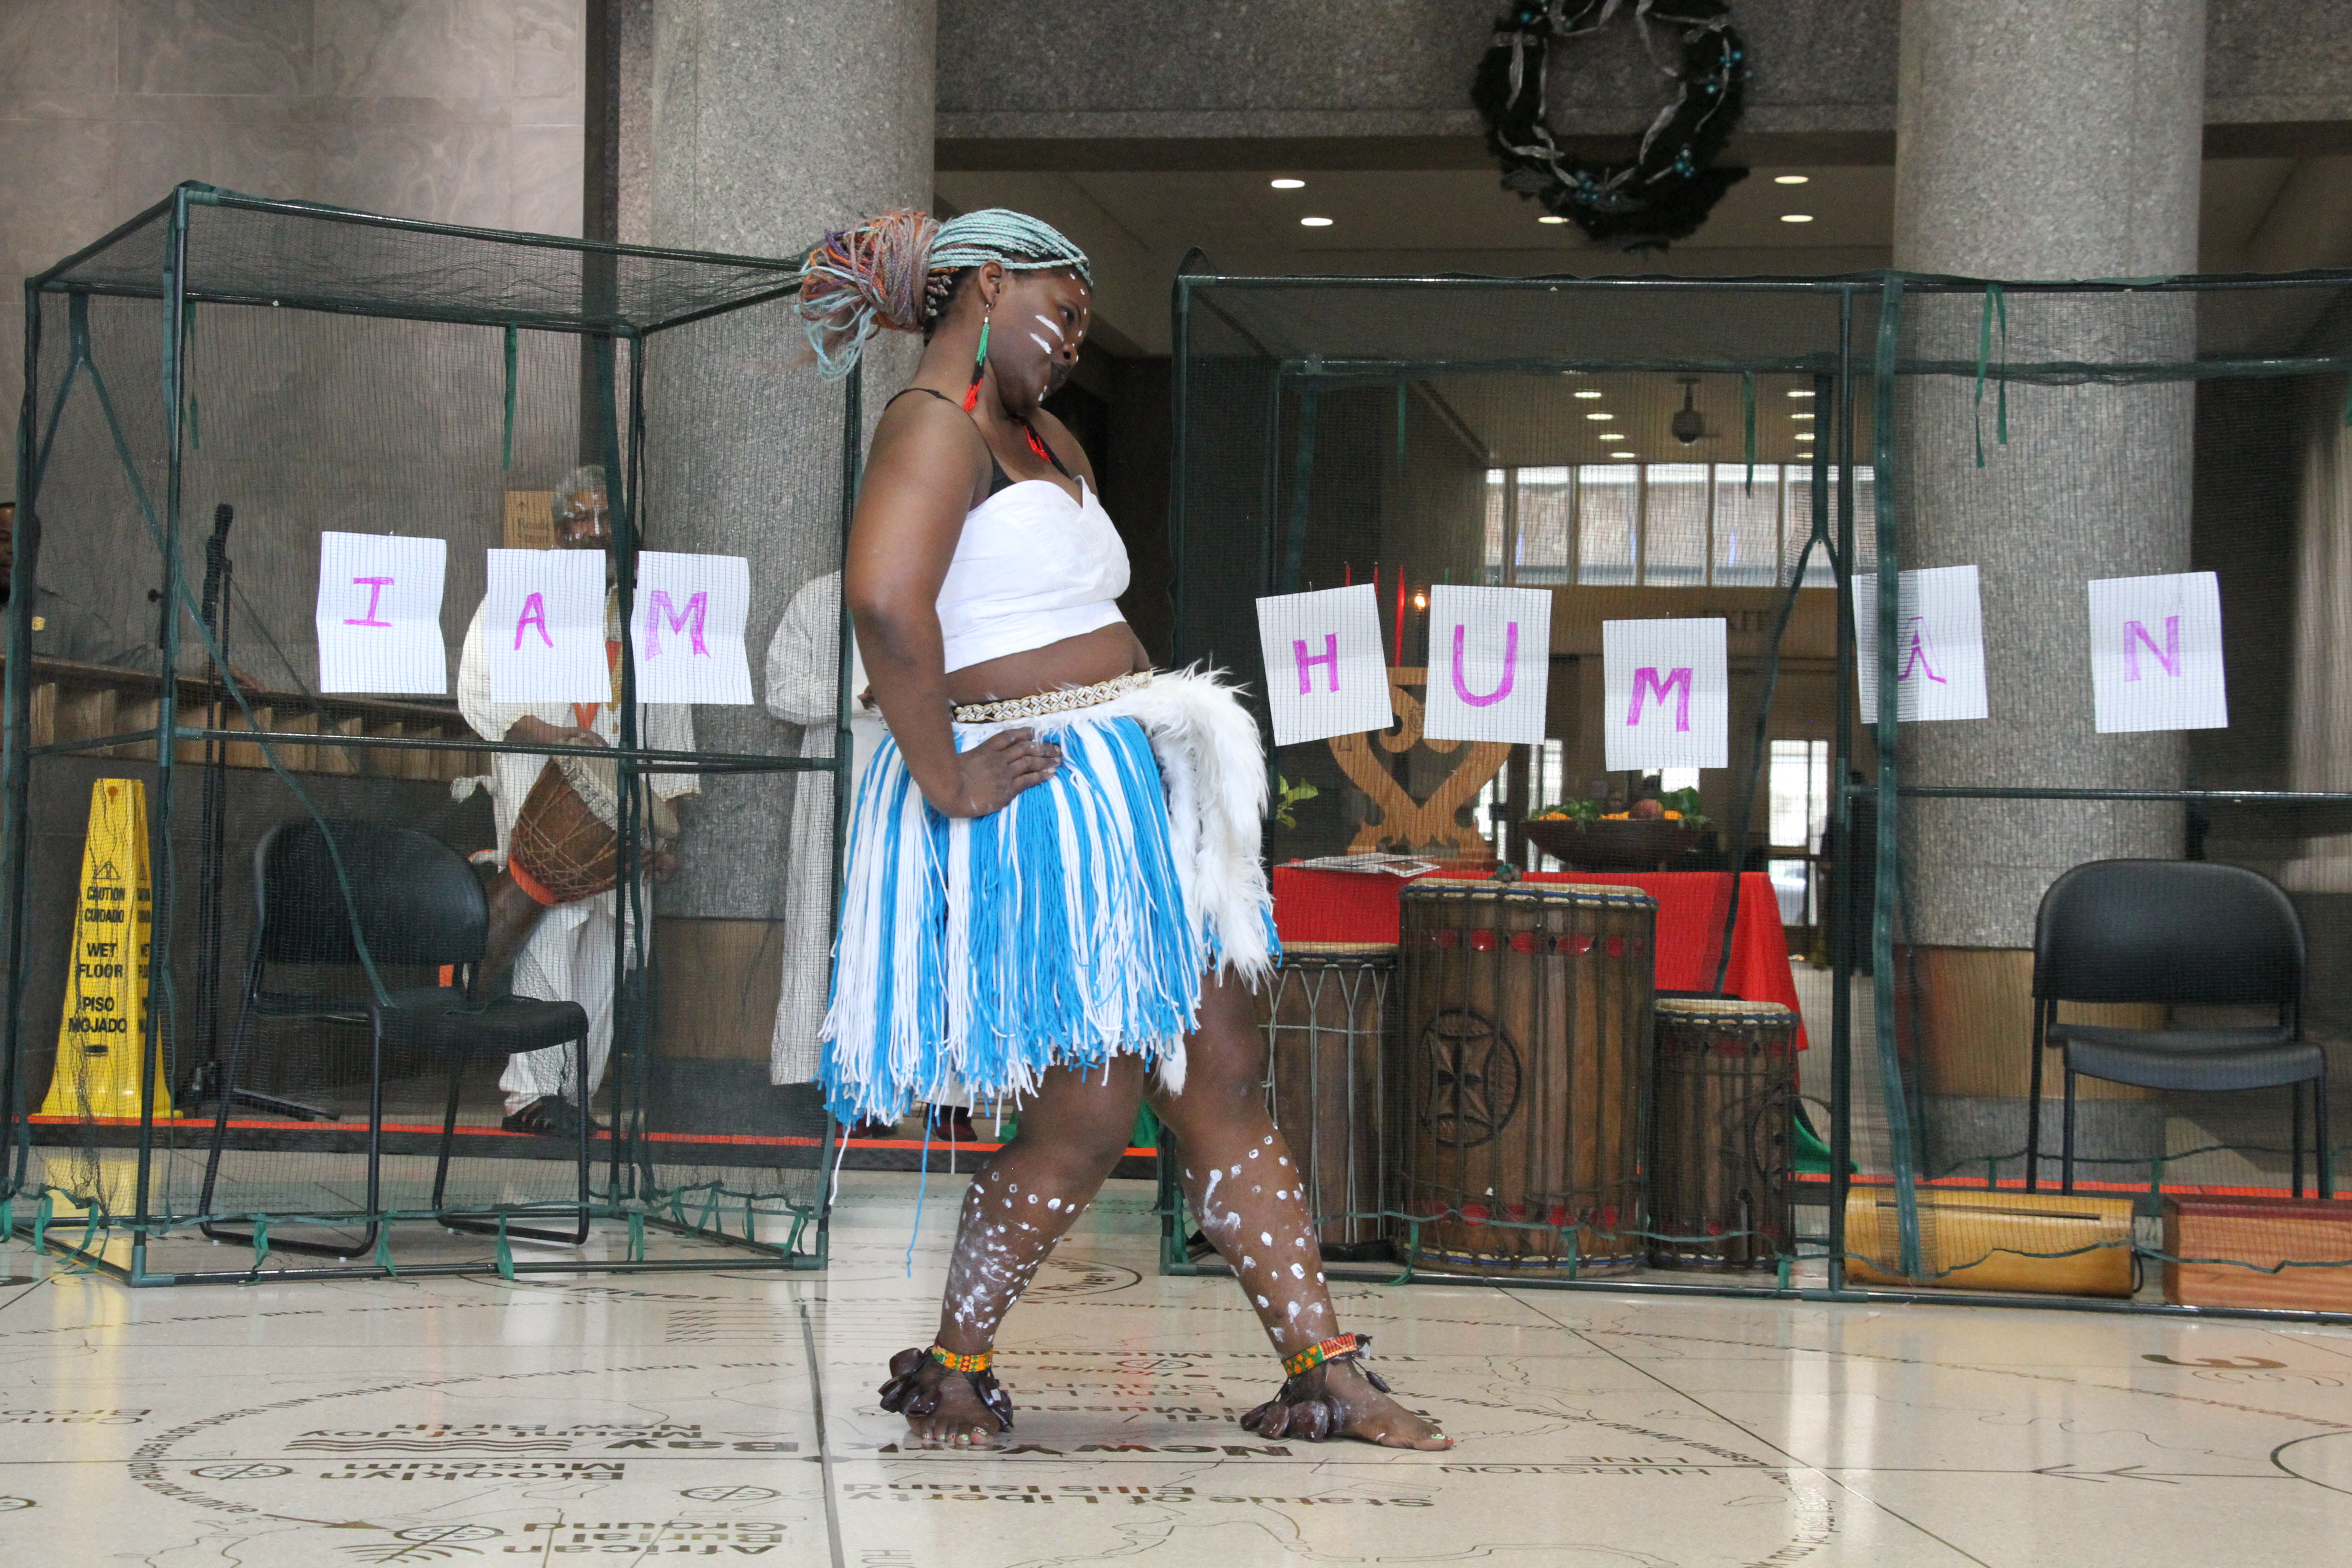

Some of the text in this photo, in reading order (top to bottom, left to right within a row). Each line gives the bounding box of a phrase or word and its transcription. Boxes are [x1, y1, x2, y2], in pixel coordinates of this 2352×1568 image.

[343, 577, 711, 662] I A M
[1293, 632, 1340, 696] H
[1452, 622, 1518, 707] U
[1626, 667, 1693, 732] M
[2123, 615, 2180, 682] N
[87, 887, 125, 901] CAUTION
[85, 909, 124, 923] CUIDADO
[87, 943, 117, 957] WET
[79, 964, 123, 978] FLOOR
[83, 997, 114, 1012] PISO
[69, 1018, 127, 1034] MOJADO
[992, 1351, 1214, 1360] Museum
[485, 1368, 597, 1380] black
[414, 1377, 482, 1387] and
[1045, 1383, 1218, 1391] Staten
[317, 1385, 409, 1398] white
[259, 1398, 321, 1409] will
[1009, 1405, 1203, 1414] Museu
[294, 1430, 412, 1438] Joy
[602, 1439, 800, 1452] Bay
[1071, 1445, 1294, 1456] New
[318, 1470, 625, 1480] Brooklyn
[1438, 1466, 1712, 1475] HURSTON
[842, 1484, 1196, 1494] Ellis Island
[845, 1492, 1435, 1507] Statue of Liberty
[523, 1522, 788, 1532] Ground
[572, 1533, 783, 1543] Burial
[502, 1545, 778, 1555] African
